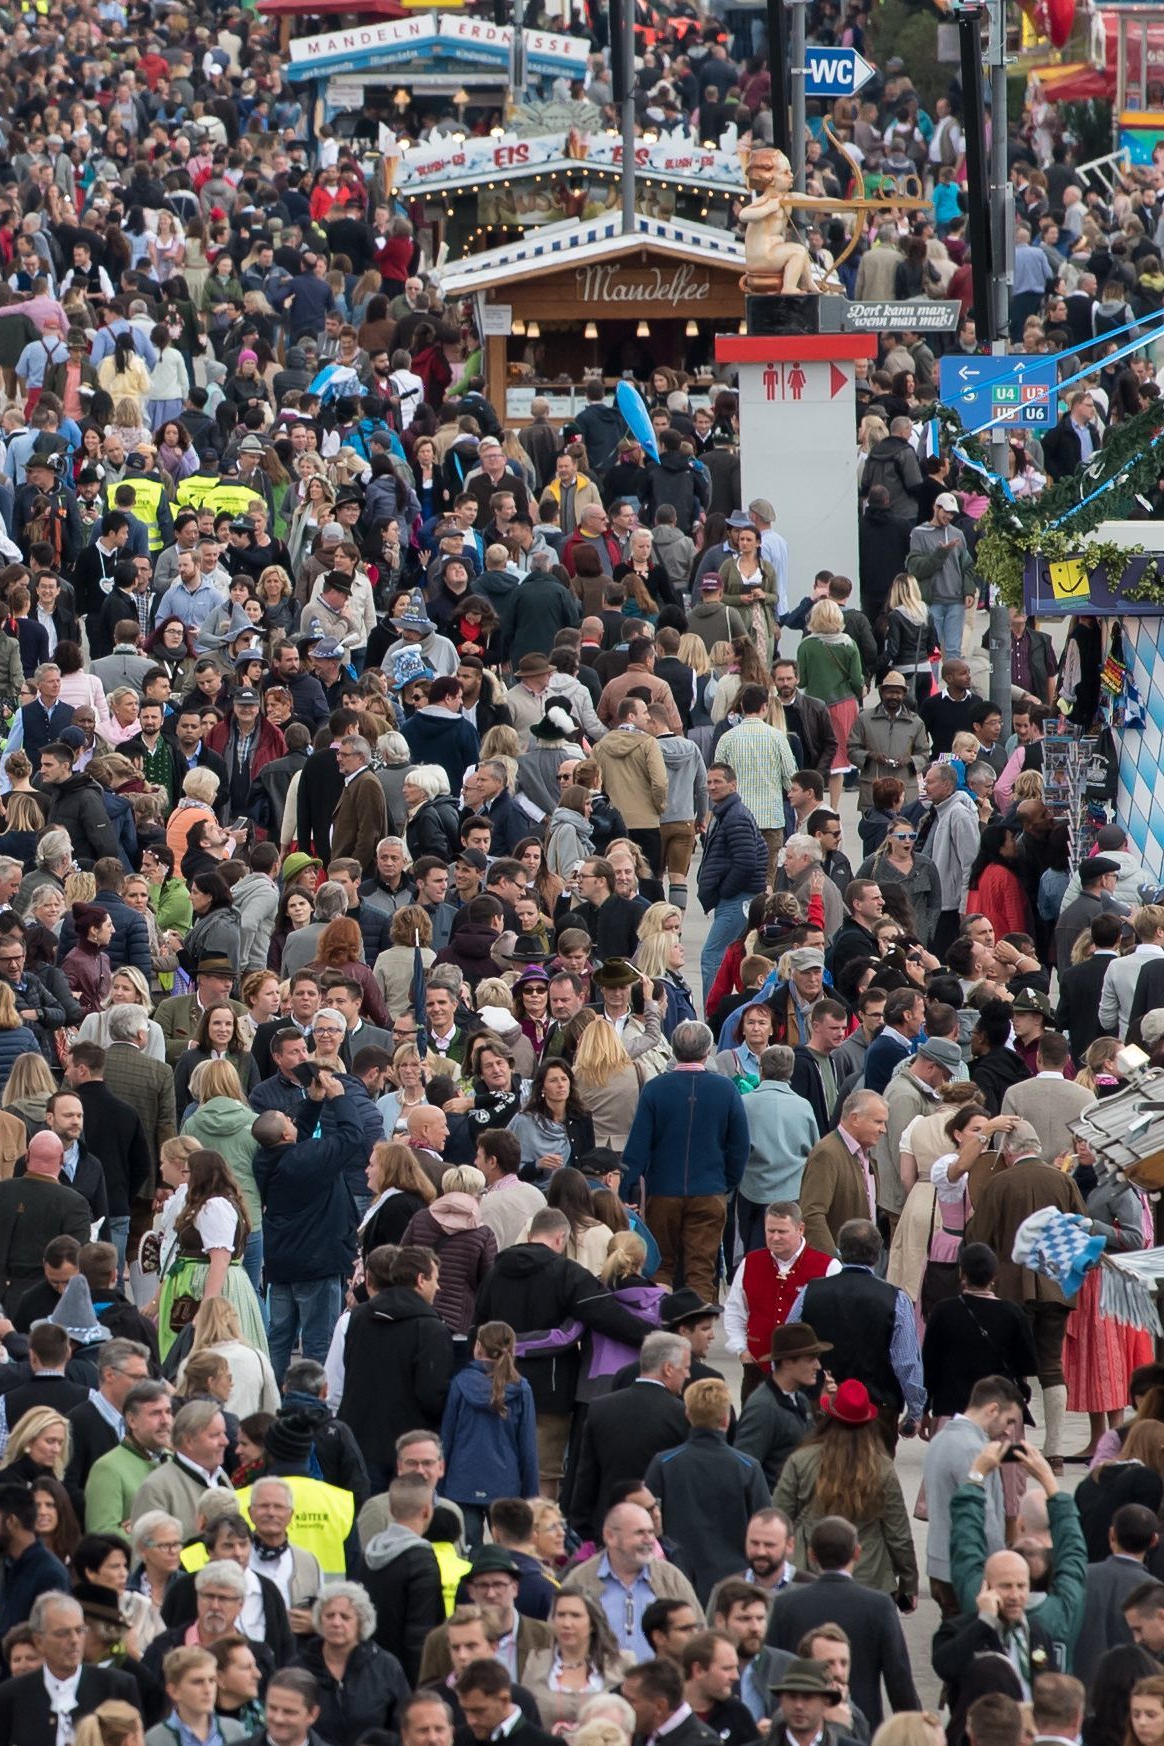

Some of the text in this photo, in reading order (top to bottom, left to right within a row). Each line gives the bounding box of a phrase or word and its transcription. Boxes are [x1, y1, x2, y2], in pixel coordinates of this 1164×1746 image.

[308, 23, 420, 54] MANDELN
[458, 23, 572, 54] ERDNSSE
[810, 59, 853, 85] WC
[493, 143, 529, 168] EIS
[612, 144, 650, 166] ES
[575, 263, 711, 307] Mandelfee
[846, 304, 883, 319] Dort
[883, 304, 915, 316] kann
[852, 317, 888, 327] wenn
[889, 317, 917, 326] man
[996, 388, 1015, 400] U4
[1025, 407, 1045, 420] U6
